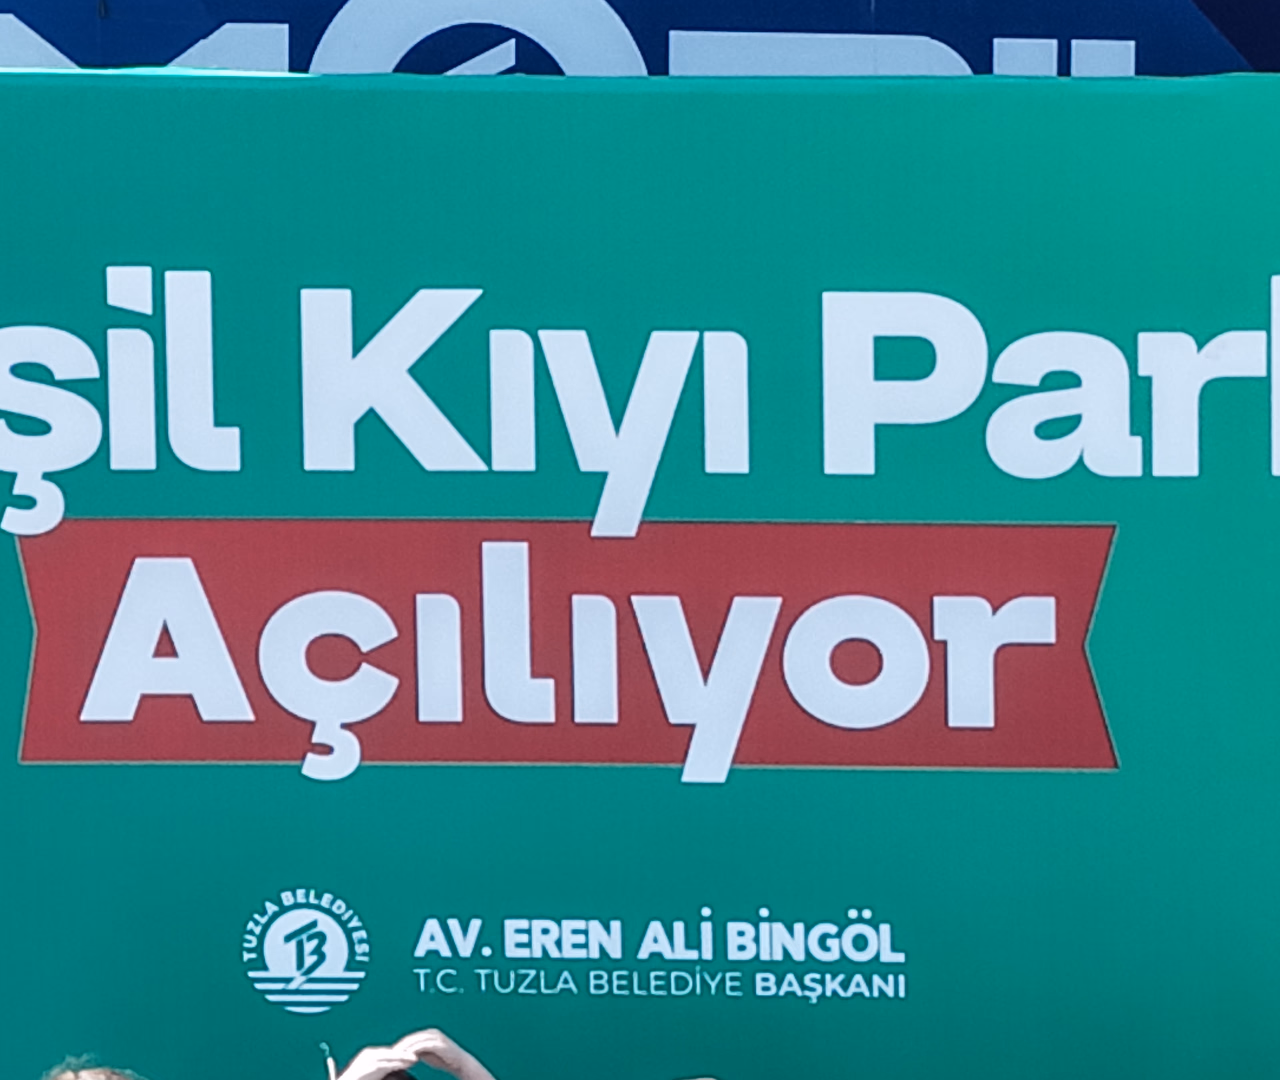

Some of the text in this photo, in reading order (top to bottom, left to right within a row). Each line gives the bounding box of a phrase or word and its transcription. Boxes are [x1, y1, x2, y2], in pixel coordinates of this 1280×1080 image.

[300, 287, 750, 538] Kıyı
[78, 540, 1057, 783] Açılıyor
[242, 900, 280, 963] TUZLA
[413, 906, 907, 964] AV. EREN ALİ BİNGÖL
[413, 966, 907, 1005] T.C. TUZLA BELEDİYE BAŞKANI
